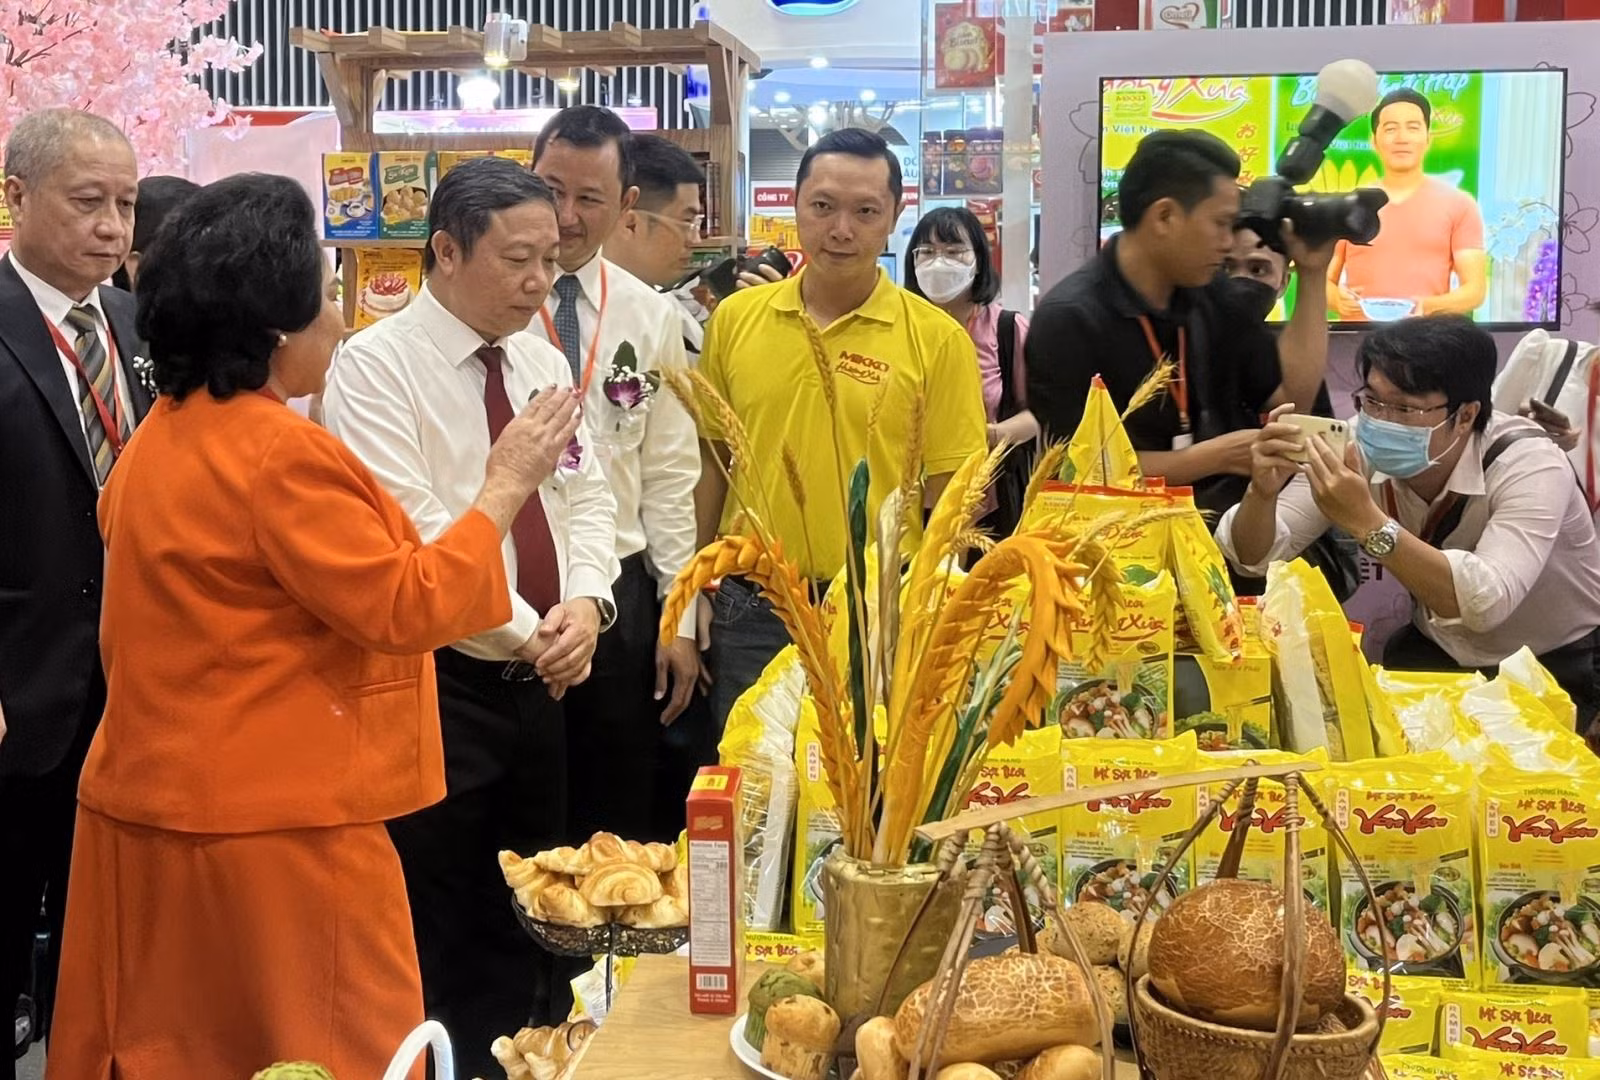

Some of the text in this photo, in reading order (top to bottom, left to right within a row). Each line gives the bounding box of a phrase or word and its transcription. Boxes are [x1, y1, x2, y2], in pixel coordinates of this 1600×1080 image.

[757, 191, 789, 202] CÔNG TY
[809, 744, 817, 780] RAMEN
[1337, 790, 1348, 827] RAMEN
[1447, 1005, 1459, 1044] RAMEN
